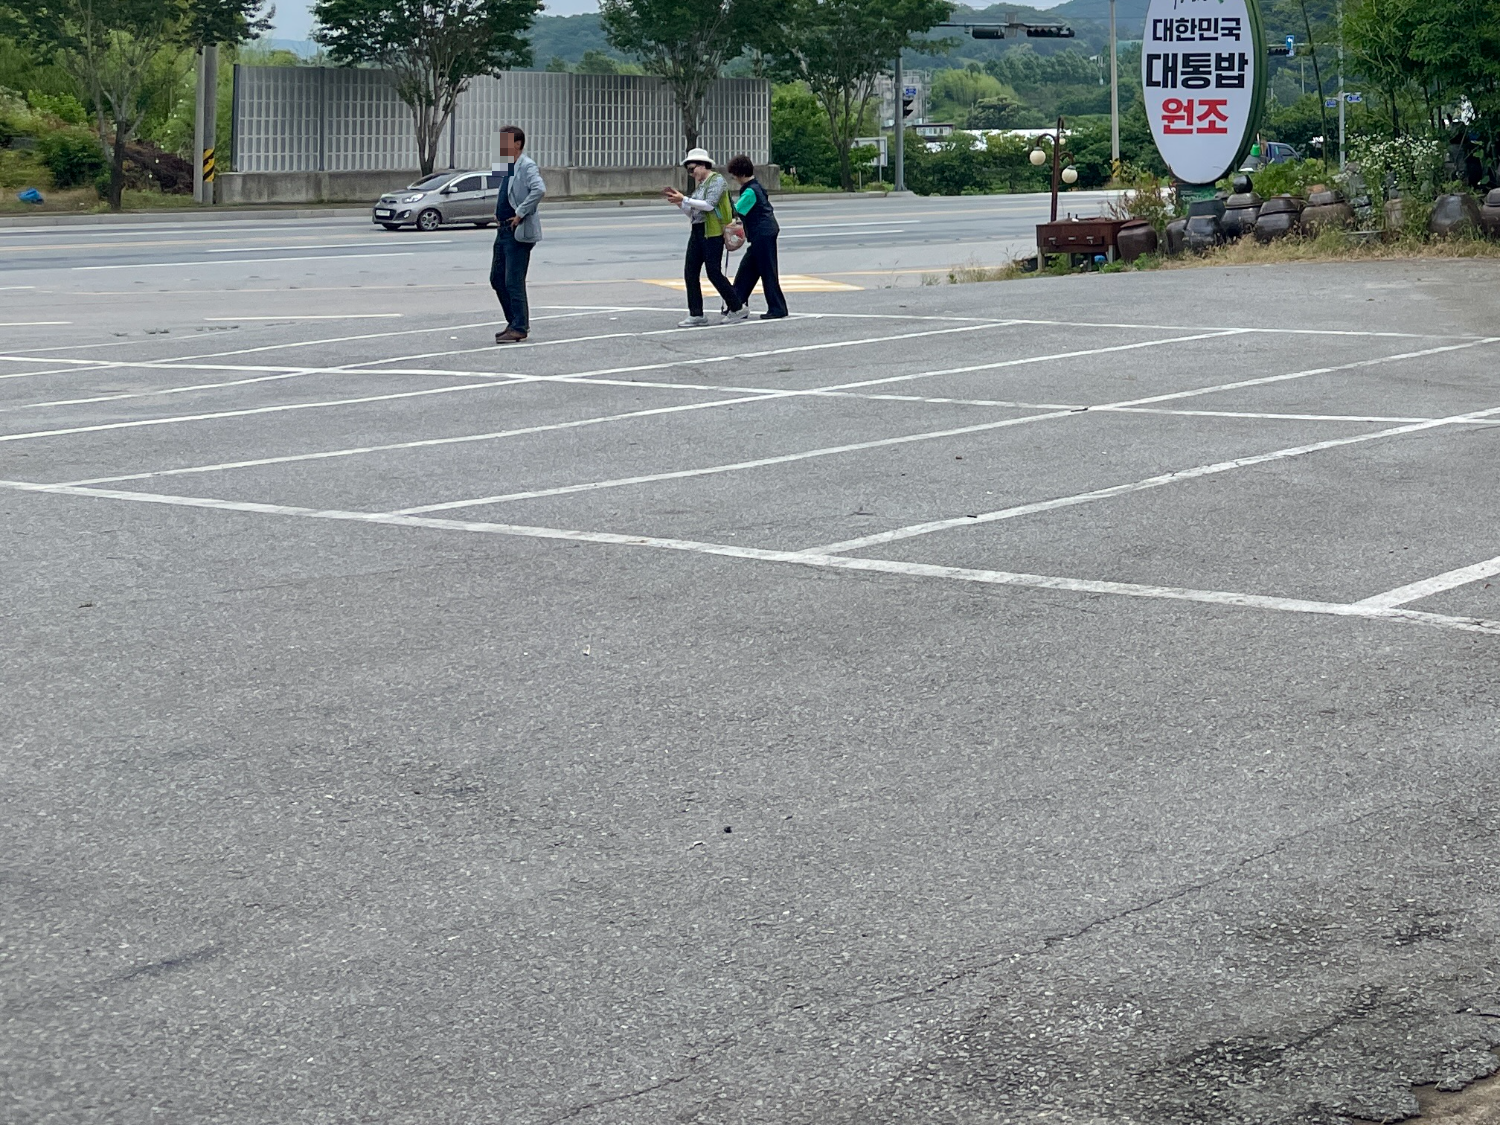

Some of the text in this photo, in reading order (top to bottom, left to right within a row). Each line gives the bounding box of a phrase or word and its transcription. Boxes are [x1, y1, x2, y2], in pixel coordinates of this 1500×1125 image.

[1152, 17, 1241, 42] 대한민국
[1146, 53, 1248, 89] 대통밥
[1161, 98, 1229, 135] 원조
